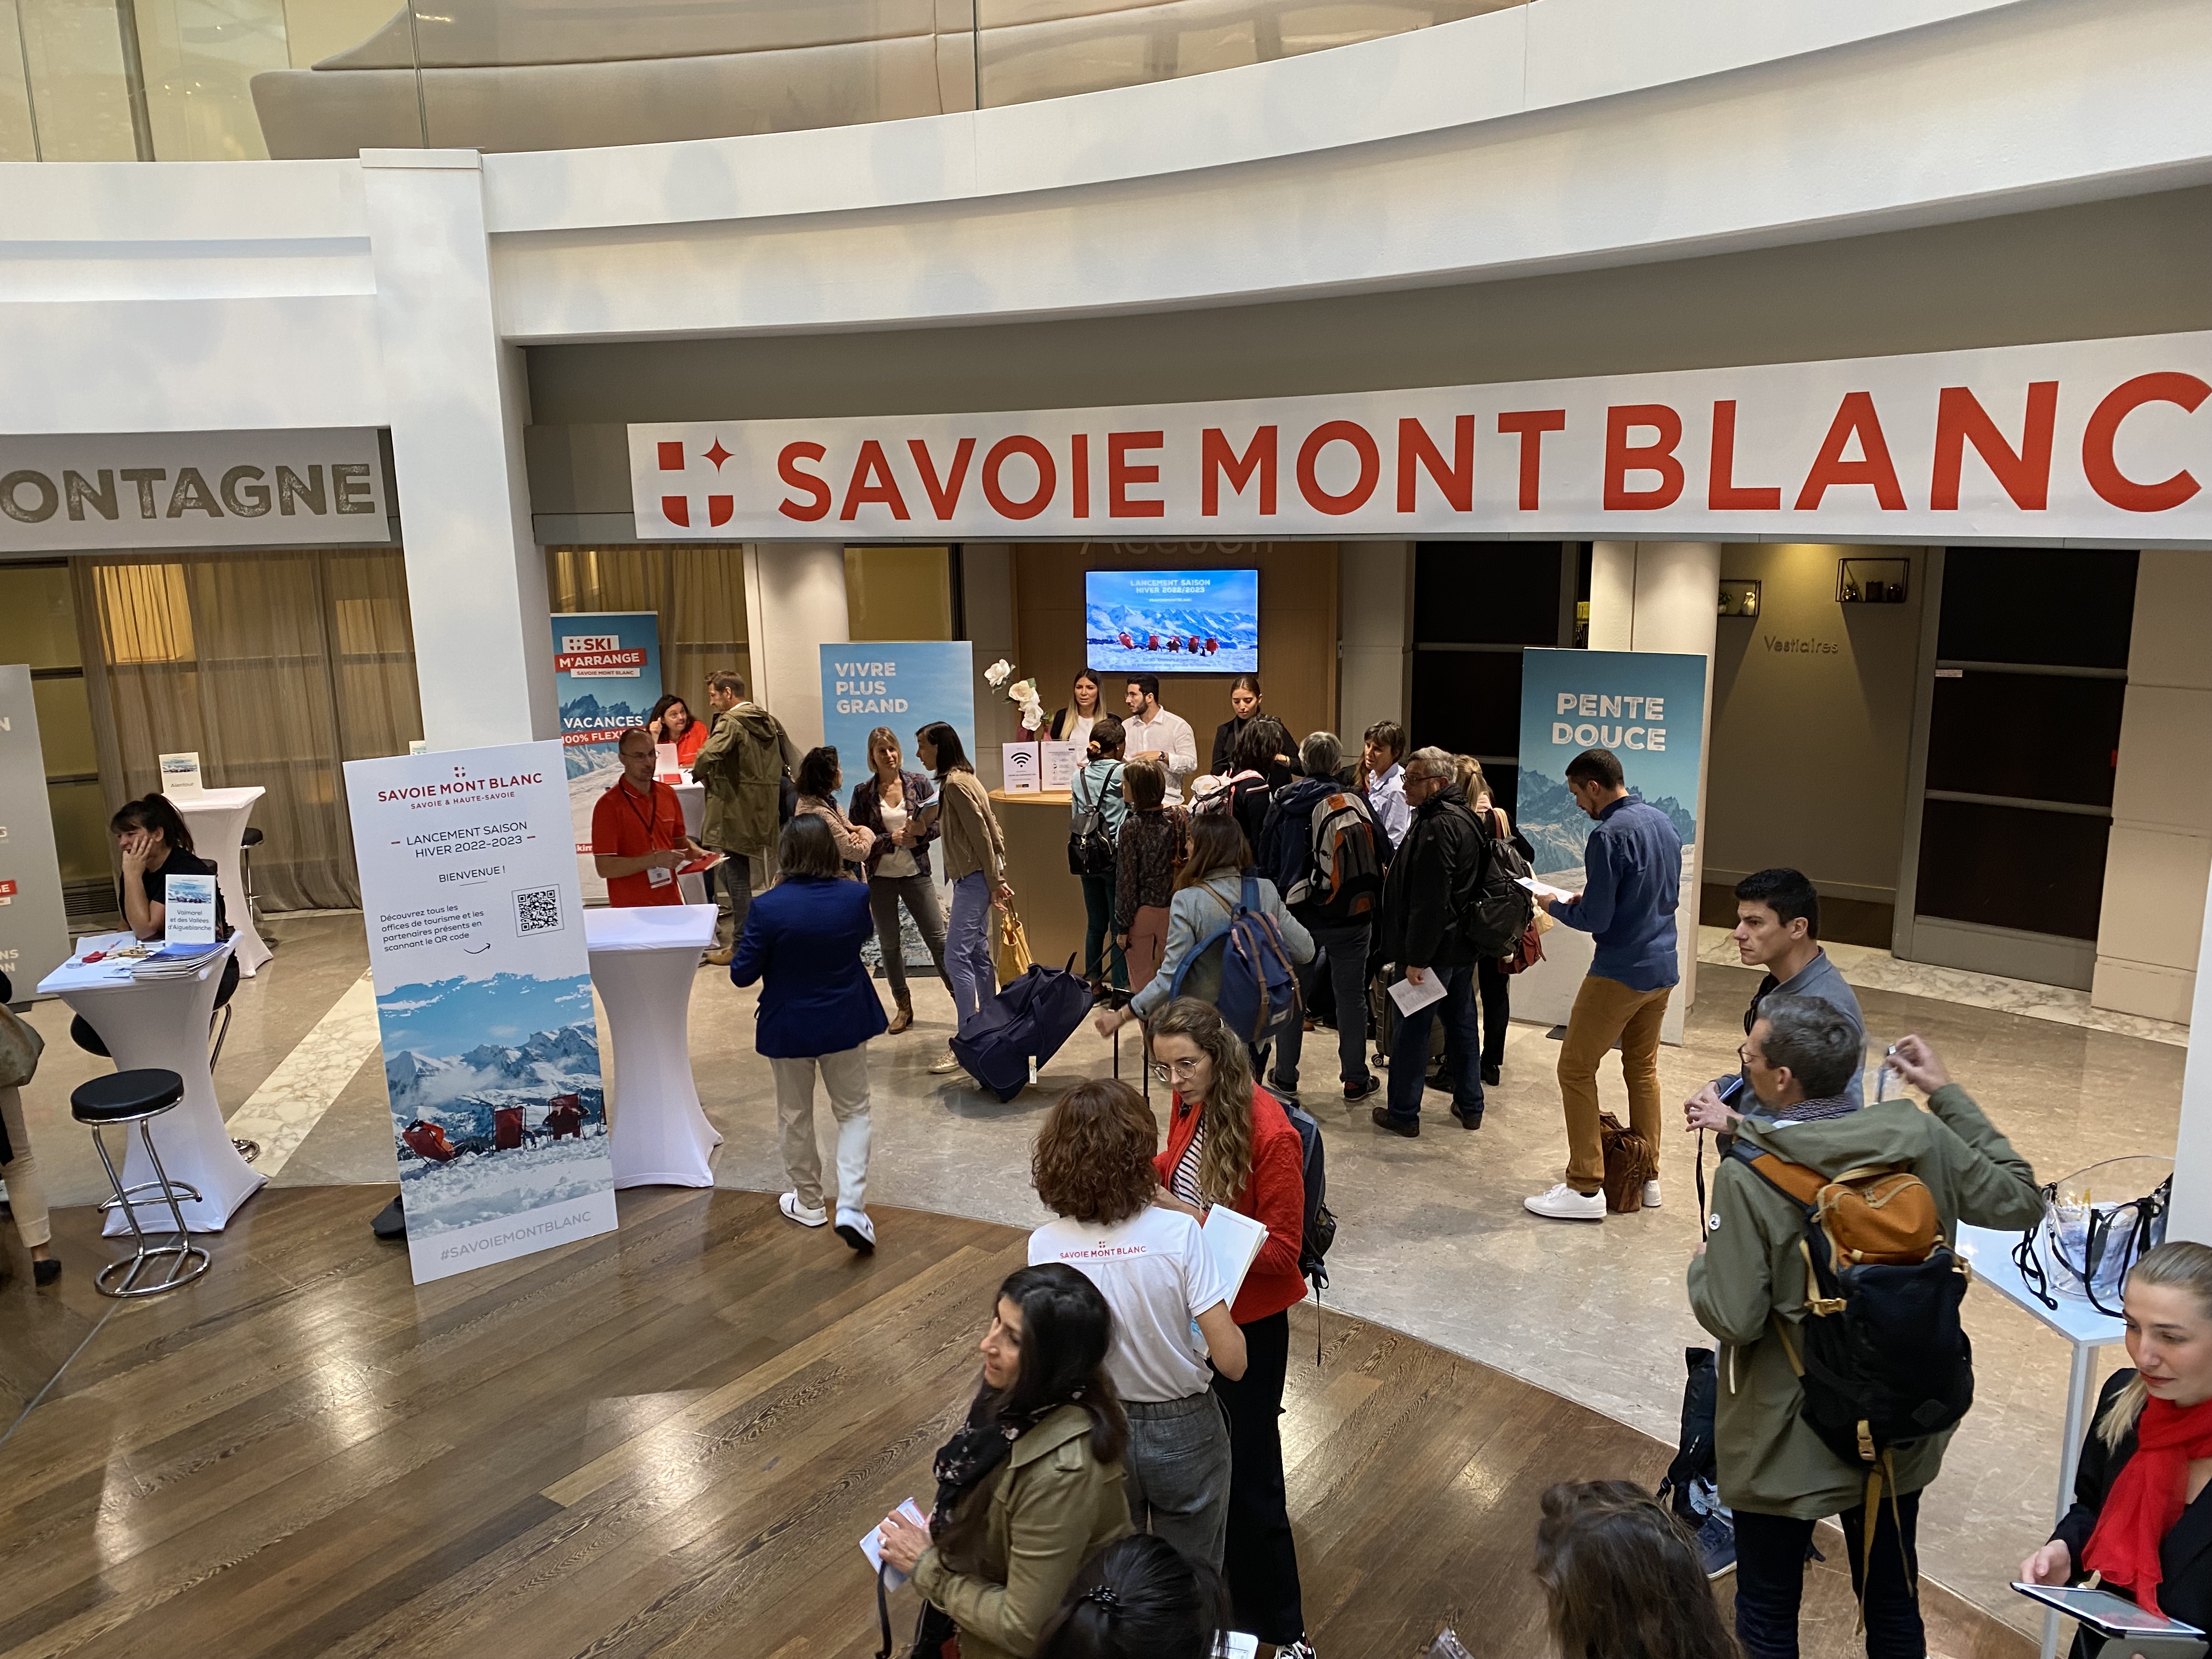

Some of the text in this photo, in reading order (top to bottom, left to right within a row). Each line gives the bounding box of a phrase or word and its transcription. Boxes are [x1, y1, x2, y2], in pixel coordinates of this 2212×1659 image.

[777, 371, 2212, 522] SAVOIE MONT BLANC
[0, 465, 375, 523] ONTAGNE
[584, 638, 612, 651] SKI
[1764, 635, 1838, 653] Vestiaires
[559, 652, 640, 668] M'ARRANGE
[834, 662, 896, 677] VIVRE
[836, 680, 886, 696] PLUS
[837, 698, 908, 713] GRAND
[1557, 693, 1664, 720] PENTE
[563, 716, 644, 729] VACANCES
[562, 734, 589, 744] 100%
[1552, 722, 1666, 751] DOUCE
[378, 773, 543, 802] SAVOIE MONT BLANC
[410, 800, 442, 809] SAVOIE
[453, 792, 515, 804] HAUTE-SAVOIE
[407, 821, 527, 845] LANCEMENT SAISON
[415, 835, 522, 858] HIVER 2022-2023
[439, 866, 500, 883] BIENVENUE
[380, 910, 425, 922] Découvrez
[427, 906, 445, 915] tous
[381, 923, 409, 932] offices
[424, 914, 460, 925] tourisme
[383, 929, 432, 944] partenaires
[434, 922, 470, 935] présents
[384, 939, 424, 952] scannant
[435, 935, 448, 944] QR
[449, 932, 470, 941] code
[441, 1211, 591, 1261] #SAVOIEMONTBLANC
[1091, 1249, 1115, 1257] MONT
[1117, 1246, 1147, 1255] BLANC
